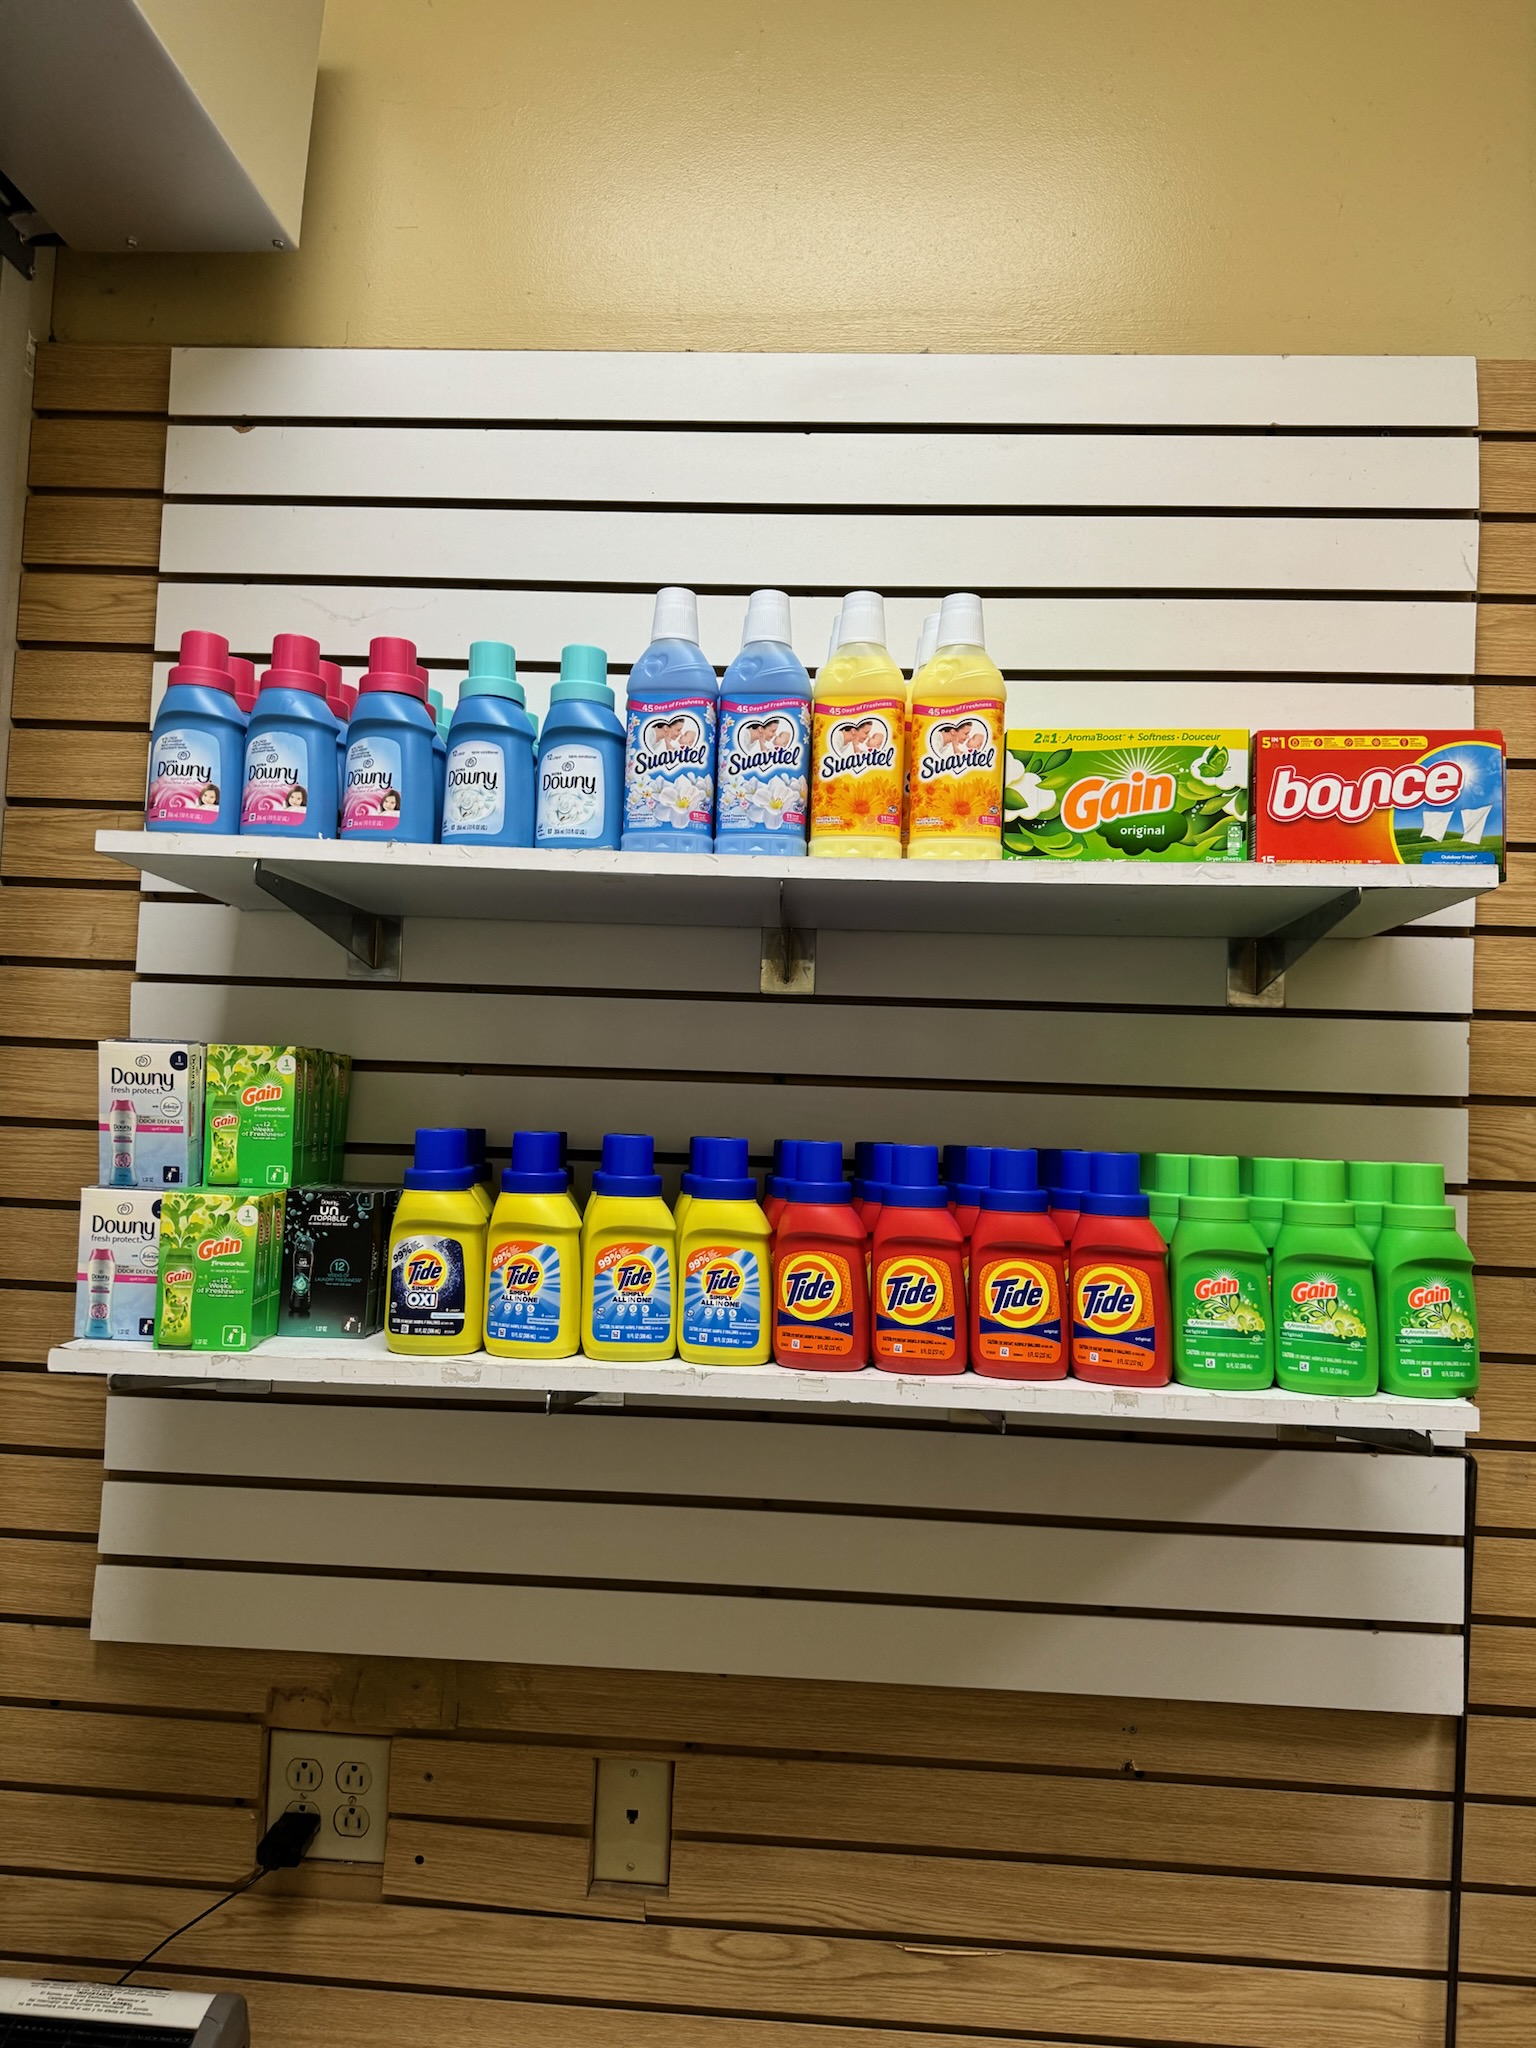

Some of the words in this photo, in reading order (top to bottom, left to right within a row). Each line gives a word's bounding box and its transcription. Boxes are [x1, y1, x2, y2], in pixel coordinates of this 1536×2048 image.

[642, 704, 654, 712] 45
[654, 703, 668, 711] Days
[737, 705, 748, 713] 45
[749, 704, 762, 712] Days
[829, 707, 841, 715] 45
[863, 701, 892, 709] Freshness
[928, 708, 940, 716] 45
[941, 706, 955, 714] Days
[962, 702, 992, 710] Freshness
[1034, 733, 1042, 743] 2
[1138, 733, 1175, 741] Softness
[1182, 733, 1220, 741] Douceur
[1262, 737, 1271, 748] 5
[1279, 737, 1285, 748] 1
[635, 745, 706, 775] Suavitel
[728, 746, 800, 775] Suavitel
[821, 747, 894, 778] Suavitel
[921, 748, 994, 779] Suavitel
[157, 761, 212, 783] Downy
[249, 765, 299, 785] Downy
[348, 772, 393, 790] Downy
[448, 770, 498, 790] Downy
[543, 774, 597, 794] Downy
[1270, 763, 1460, 820] bounce
[1062, 770, 1174, 830] Gain
[1120, 825, 1165, 838] original
[111, 1067, 174, 1092] Downy
[111, 1086, 130, 1094] fresh
[242, 1085, 282, 1105] Gain
[213, 1116, 237, 1128] Gain
[92, 1215, 155, 1241] Downy
[198, 1238, 242, 1260] Gain
[393, 1246, 412, 1263] 99%
[493, 1250, 511, 1266] 99%
[335, 1262, 345, 1271] 12
[598, 1251, 621, 1268] 99%
[688, 1255, 709, 1271] 99%
[166, 1272, 193, 1283] Gain
[408, 1260, 443, 1285] Tide
[507, 1265, 540, 1288] Tide
[618, 1266, 652, 1290] Tide
[706, 1270, 740, 1293] Tide
[787, 1272, 835, 1307] Tide
[886, 1276, 937, 1311] Tide
[991, 1279, 1043, 1314] Tide
[1195, 1277, 1238, 1299] Gain
[1292, 1281, 1336, 1302] Gain
[1409, 1286, 1450, 1309] Gain
[407, 1292, 436, 1308] OXI
[1083, 1284, 1135, 1318] Tide
